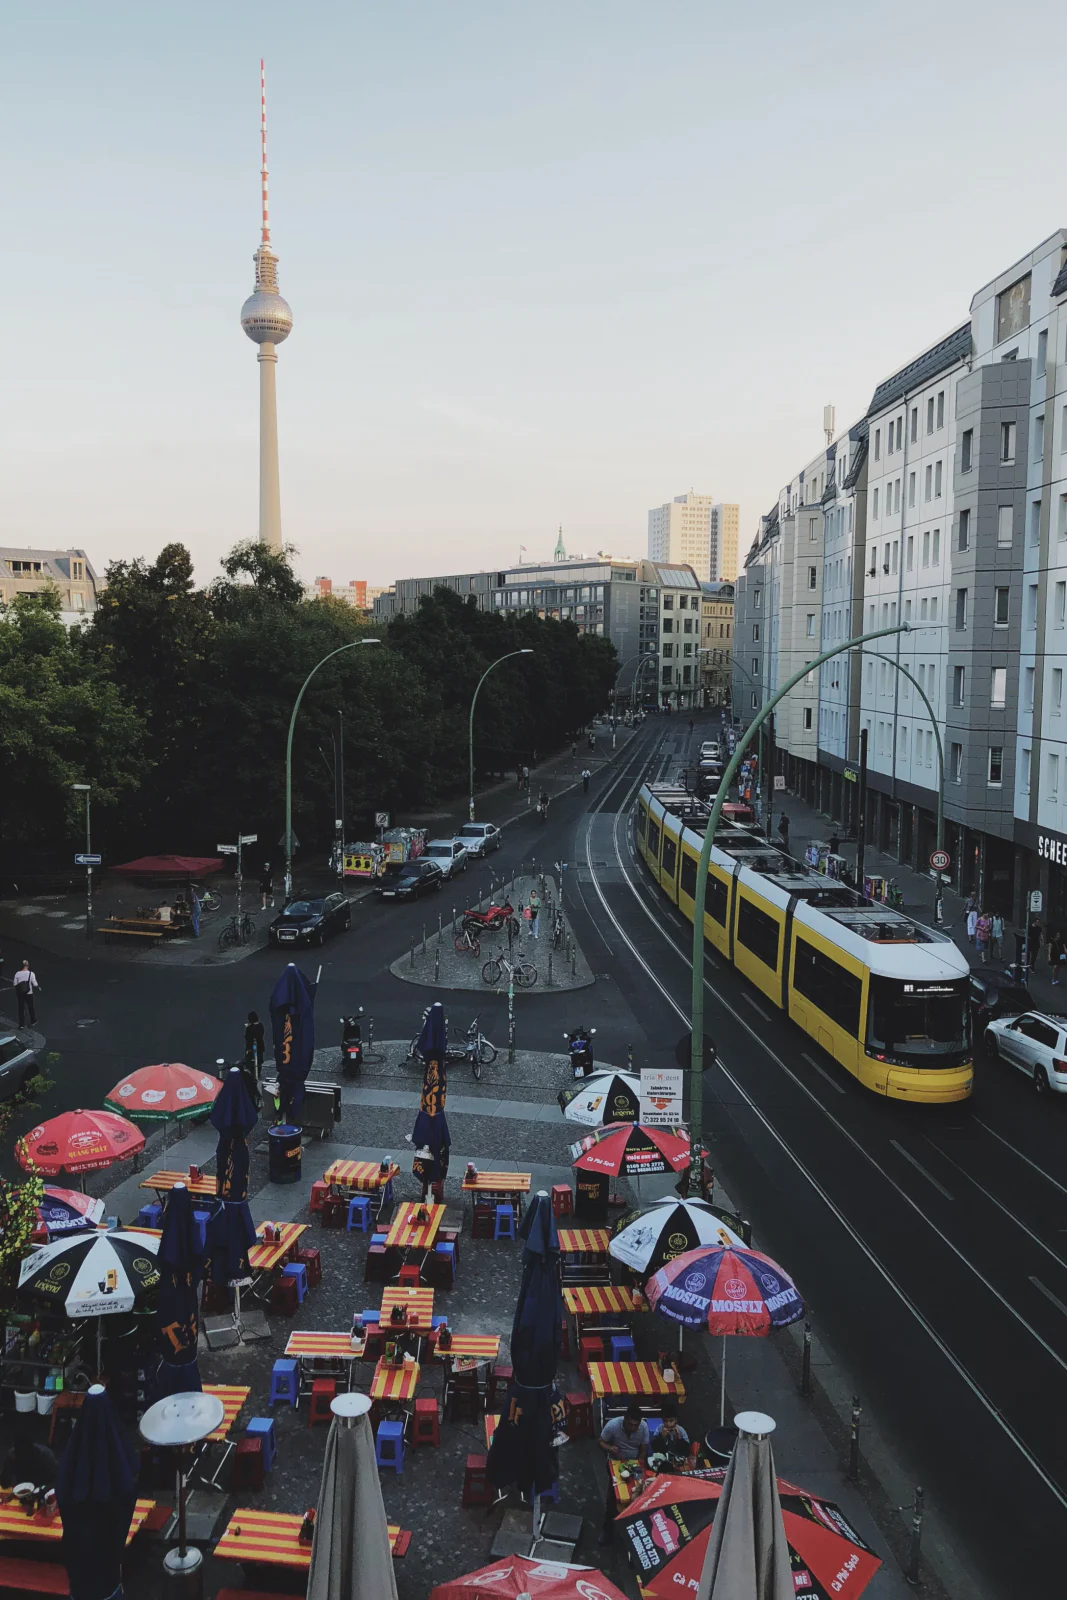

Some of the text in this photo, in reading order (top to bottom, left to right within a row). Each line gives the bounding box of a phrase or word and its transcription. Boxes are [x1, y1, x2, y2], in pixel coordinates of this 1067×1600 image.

[934, 856, 946, 865] 30
[68, 1149, 90, 1159] QUANG
[47, 1216, 88, 1231] MOSFLY
[34, 1280, 62, 1294] Legend
[664, 1285, 710, 1311] MOSFLY
[764, 1288, 799, 1313] MOSFLY
[711, 1299, 764, 1314] MOSFLY
[672, 1572, 701, 1592] Cà Ph
